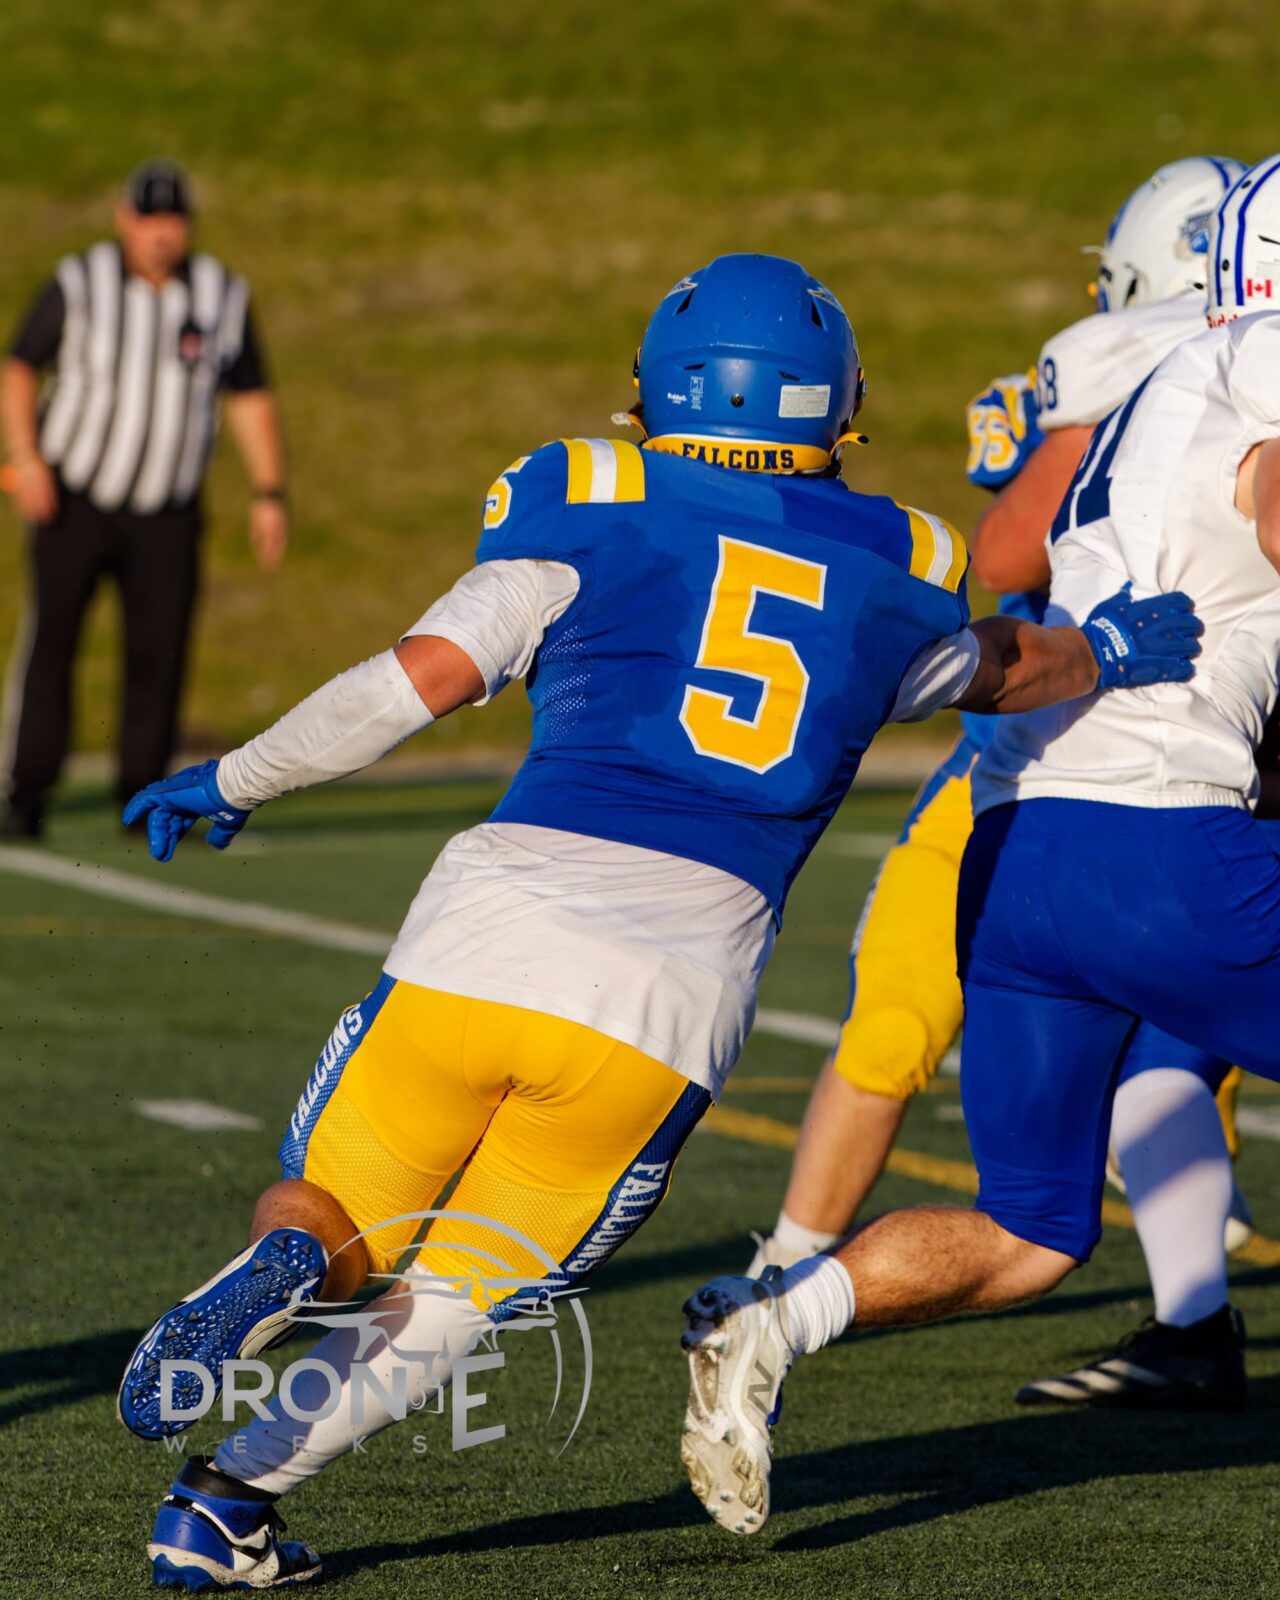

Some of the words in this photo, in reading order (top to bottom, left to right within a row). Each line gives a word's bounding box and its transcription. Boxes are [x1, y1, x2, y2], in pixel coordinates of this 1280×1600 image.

[483, 455, 533, 530] 5
[682, 442, 794, 470] FALCONS
[679, 534, 828, 775] 5
